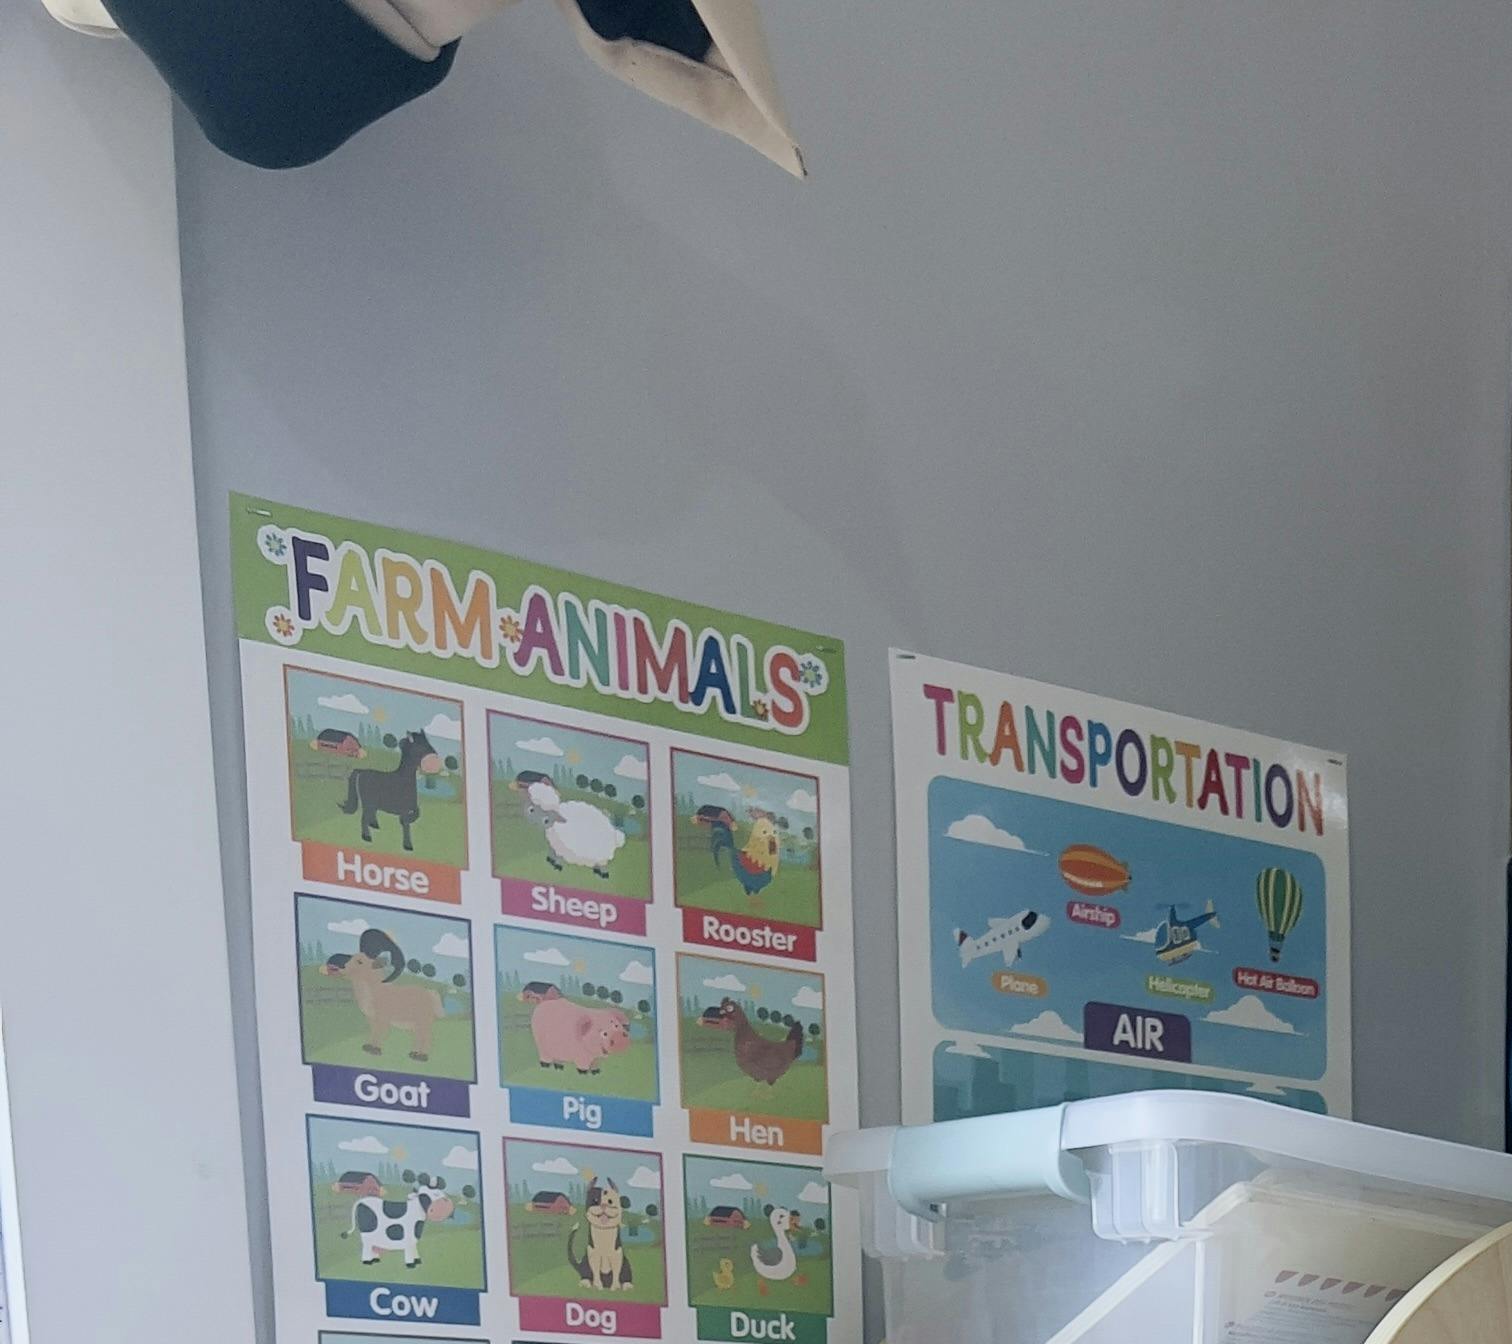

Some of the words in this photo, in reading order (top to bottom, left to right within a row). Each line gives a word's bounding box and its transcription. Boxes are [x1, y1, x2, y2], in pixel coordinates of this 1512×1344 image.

[291, 535, 492, 660] FARM
[514, 592, 805, 728] ANIMALS
[922, 683, 1324, 836] TRANSPORTATION
[336, 851, 430, 895] Horse
[531, 886, 617, 927] Sheep
[1071, 902, 1117, 927] Airship
[702, 915, 797, 952] Rooster
[1000, 974, 1040, 995] Plane
[1149, 975, 1212, 999] Helicopter
[1238, 971, 1258, 986] Hot
[1260, 975, 1275, 988] Air
[1276, 977, 1316, 997] Balloon
[1112, 1013, 1164, 1053] AIR
[354, 1075, 430, 1109] Goat
[563, 1097, 602, 1129] Pig
[730, 1117, 784, 1147] Hen
[369, 1289, 438, 1318] Cow
[565, 1302, 617, 1333] Dog
[730, 1311, 796, 1341] Duck
